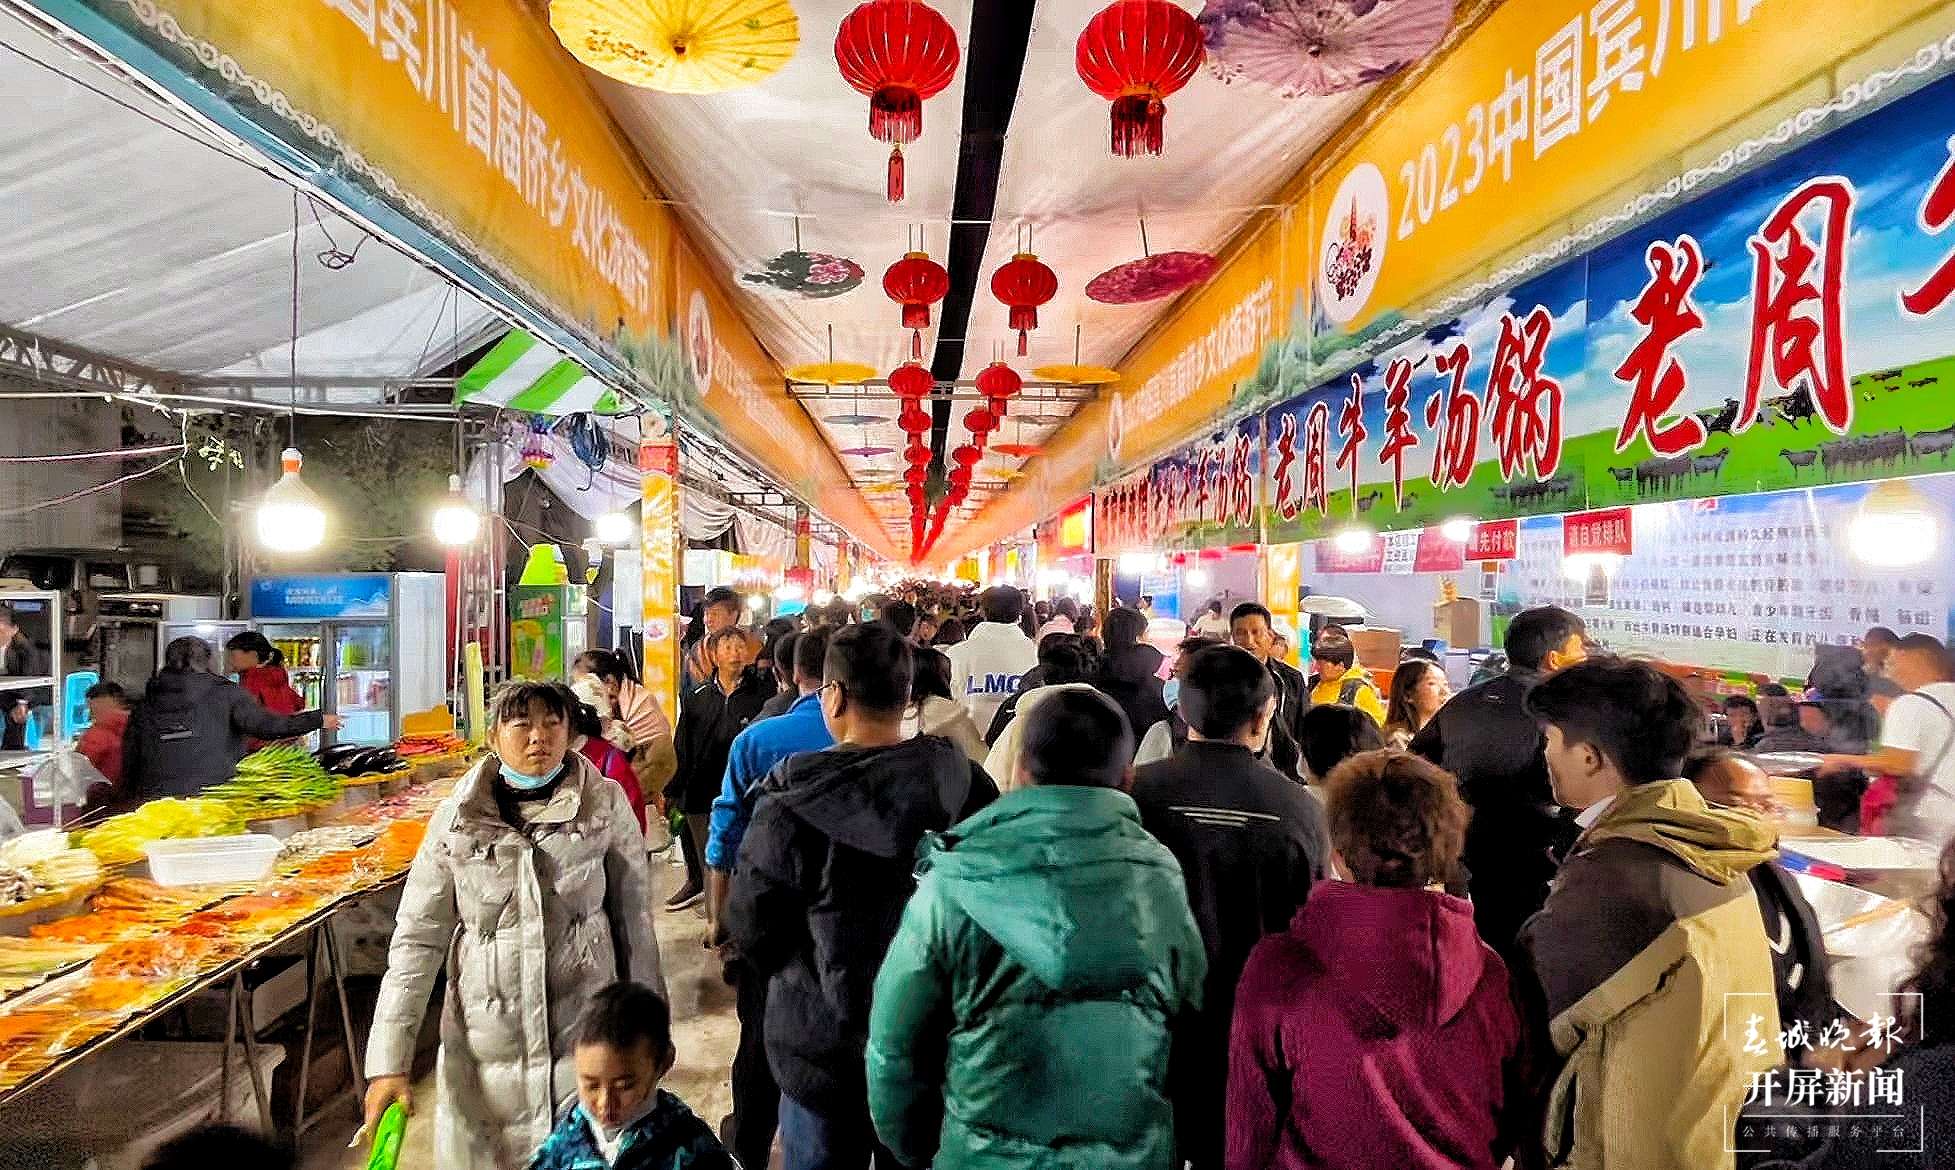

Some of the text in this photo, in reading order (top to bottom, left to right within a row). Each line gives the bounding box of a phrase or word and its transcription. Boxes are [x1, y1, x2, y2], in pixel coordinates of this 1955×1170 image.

[309, 0, 650, 313] 宾川首届侨乡文化旅游节
[1396, 0, 1763, 239] 2023中国宾川
[1273, 303, 1565, 521] 老周牛羊汤锅
